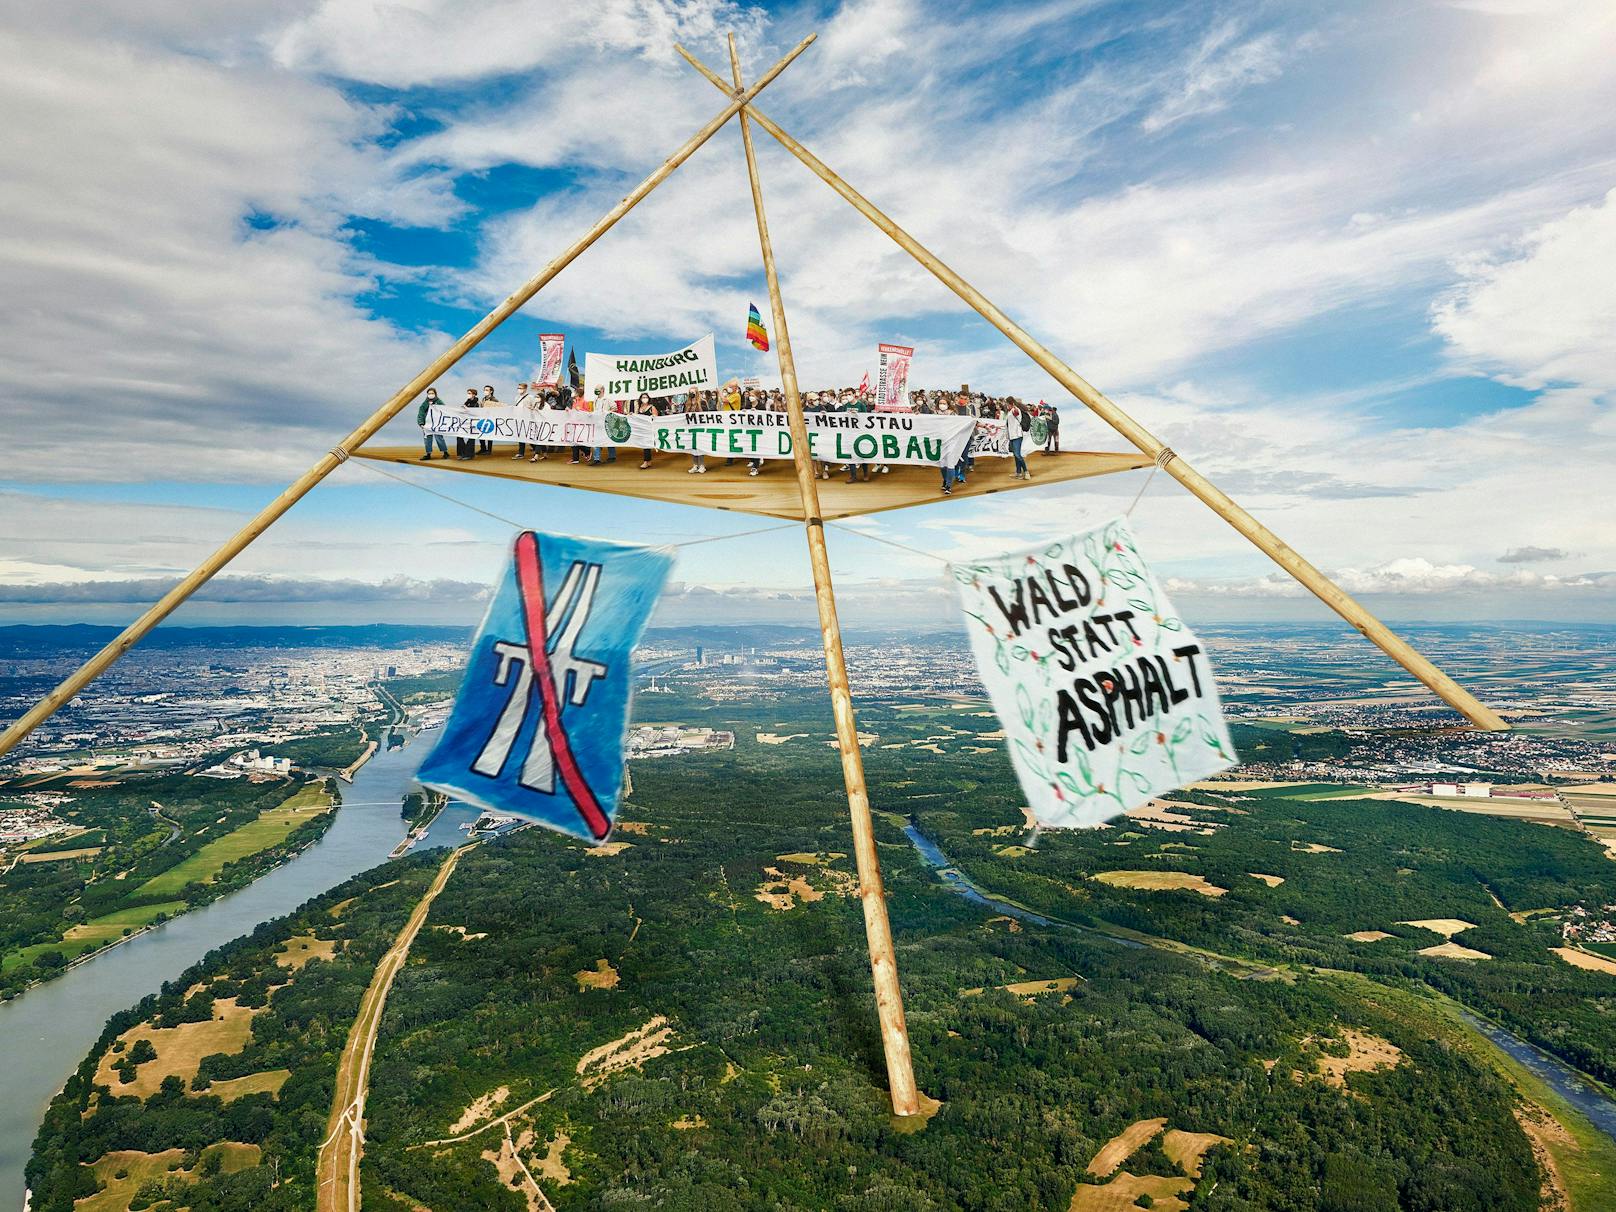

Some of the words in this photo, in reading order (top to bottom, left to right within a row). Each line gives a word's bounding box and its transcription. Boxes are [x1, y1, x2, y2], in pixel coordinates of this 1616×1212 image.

[616, 348, 699, 373] HAINBURG
[880, 353, 888, 366] NEIN
[609, 379, 633, 394] IST
[636, 368, 708, 393] ÜBERALL!
[878, 368, 888, 405] STADTSTRASSE
[560, 422, 595, 443] JETZT!
[685, 413, 723, 425] MEHR
[815, 415, 859, 429] MEHR
[865, 415, 914, 431] STAU
[657, 428, 764, 452] RETTET
[778, 430, 819, 457] DE
[836, 432, 943, 462] LOBAU
[988, 563, 1093, 637] WALD
[1047, 610, 1142, 672] STATT
[1056, 644, 1203, 764] ASPHALT
